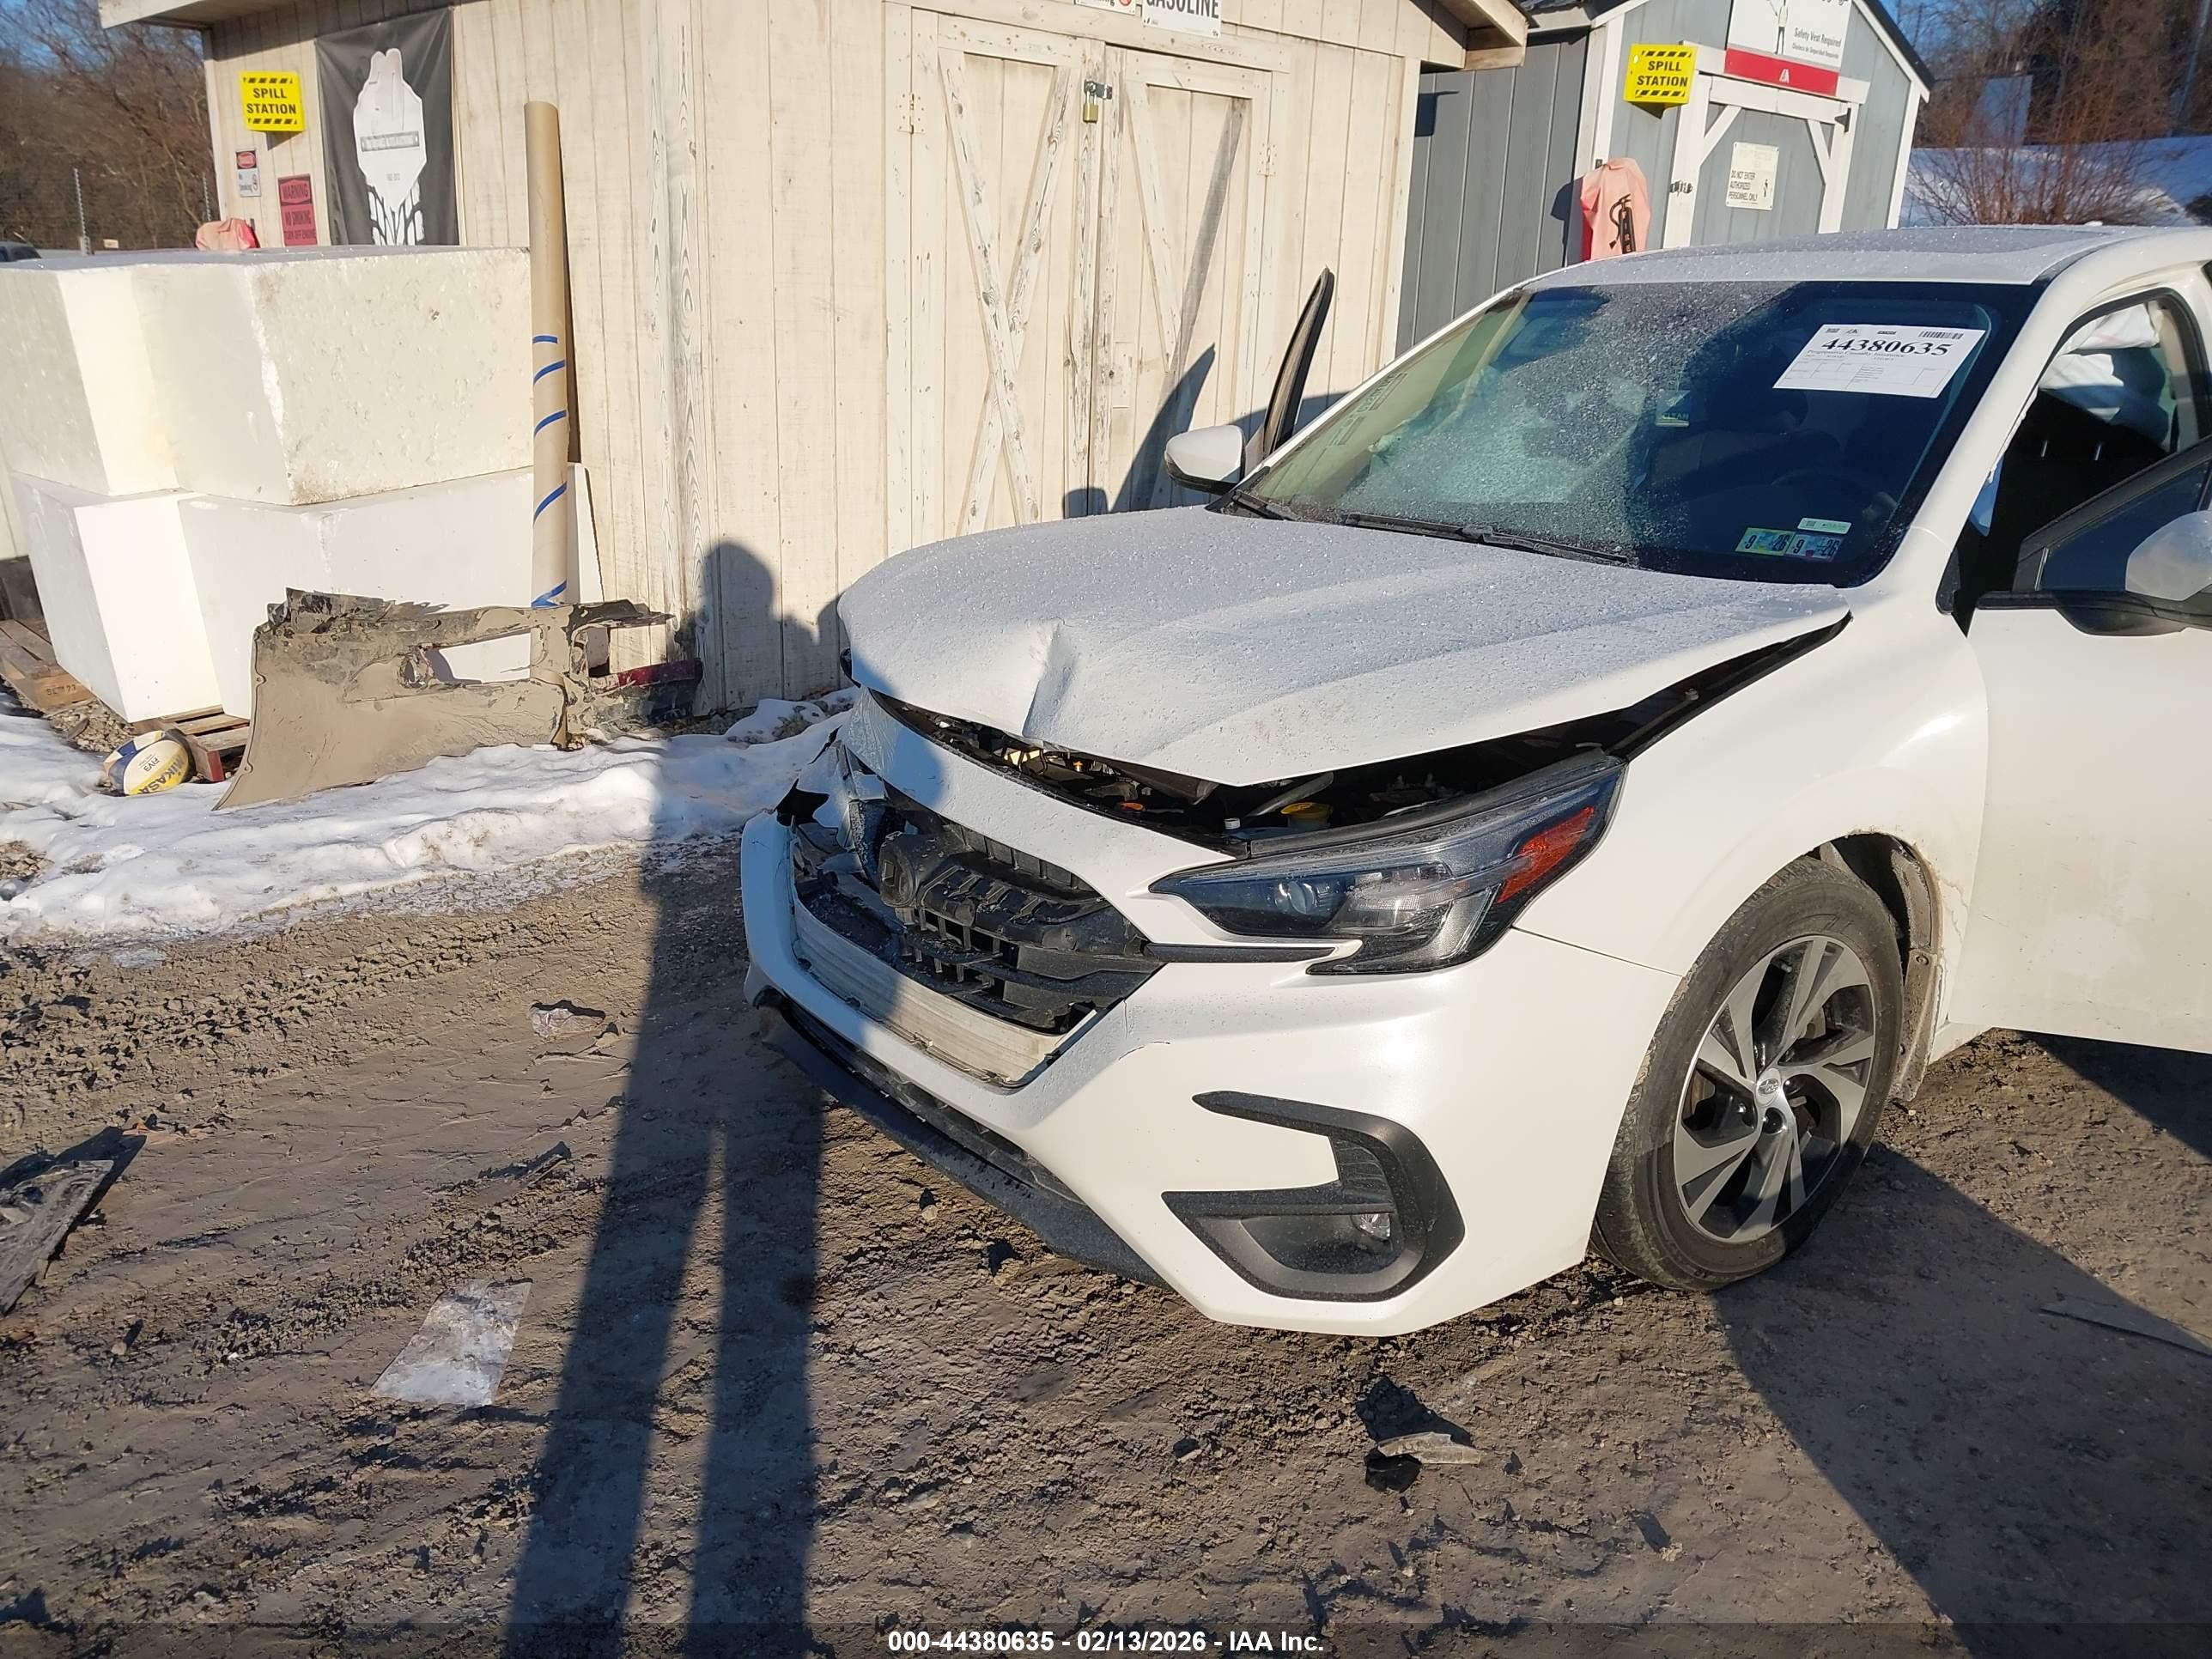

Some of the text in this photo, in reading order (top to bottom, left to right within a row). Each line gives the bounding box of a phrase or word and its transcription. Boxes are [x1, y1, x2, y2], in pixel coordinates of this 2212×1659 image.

[1146, 0, 1219, 19] LINE
[1794, 27, 1809, 41] Safety
[1810, 31, 1820, 42] Vest
[1648, 60, 1682, 71] SPILL
[1637, 75, 1688, 87] STATION
[253, 88, 288, 99] SPILL
[246, 103, 296, 114] STATION
[283, 183, 309, 198] WARNING
[285, 209, 312, 225] NO SMOKING
[1821, 337, 1954, 356] 44380635
[1745, 534, 1757, 550] 9
[1793, 539, 1805, 554] 9
